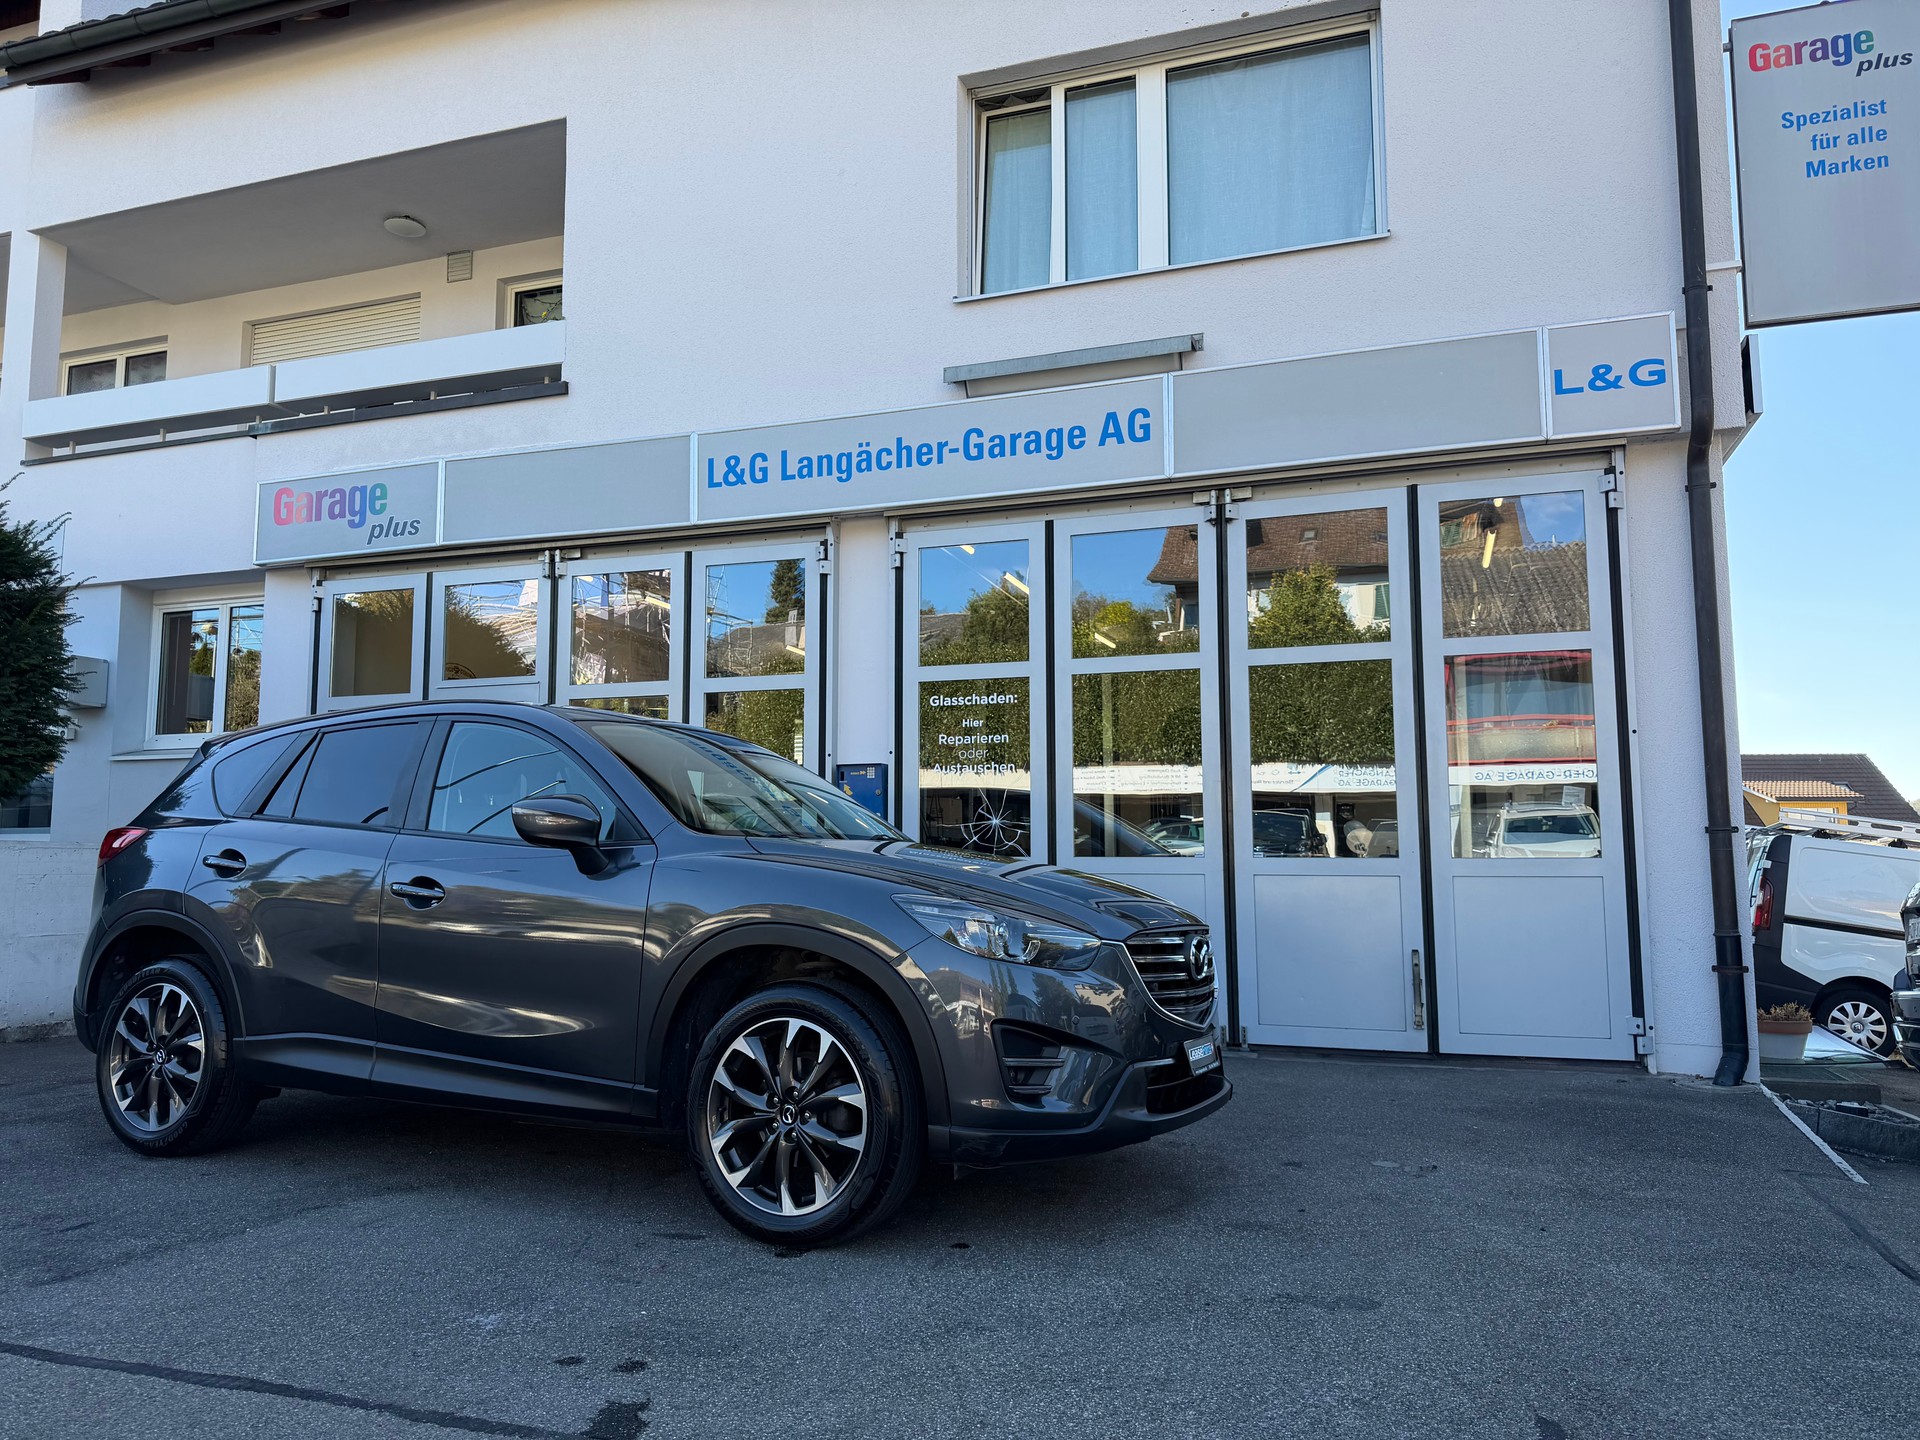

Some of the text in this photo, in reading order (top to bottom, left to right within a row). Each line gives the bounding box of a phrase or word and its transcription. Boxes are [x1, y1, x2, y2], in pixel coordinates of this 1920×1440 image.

[1748, 30, 1875, 73] Garage
[1855, 52, 1913, 77] plus
[1781, 99, 1888, 132] Spezialist
[1810, 126, 1888, 151] für alle
[1805, 154, 1890, 178] Marken
[1553, 358, 1667, 396] L&G
[707, 407, 1152, 489] L&G Langächer-Garage AG
[273, 482, 388, 529] Garage
[366, 516, 422, 546] plus
[929, 693, 1018, 707] Glasschaden:
[962, 718, 984, 728] Hier
[938, 733, 1009, 746] Reparieren
[958, 747, 988, 760] oder
[933, 761, 1016, 775] Austauschen
